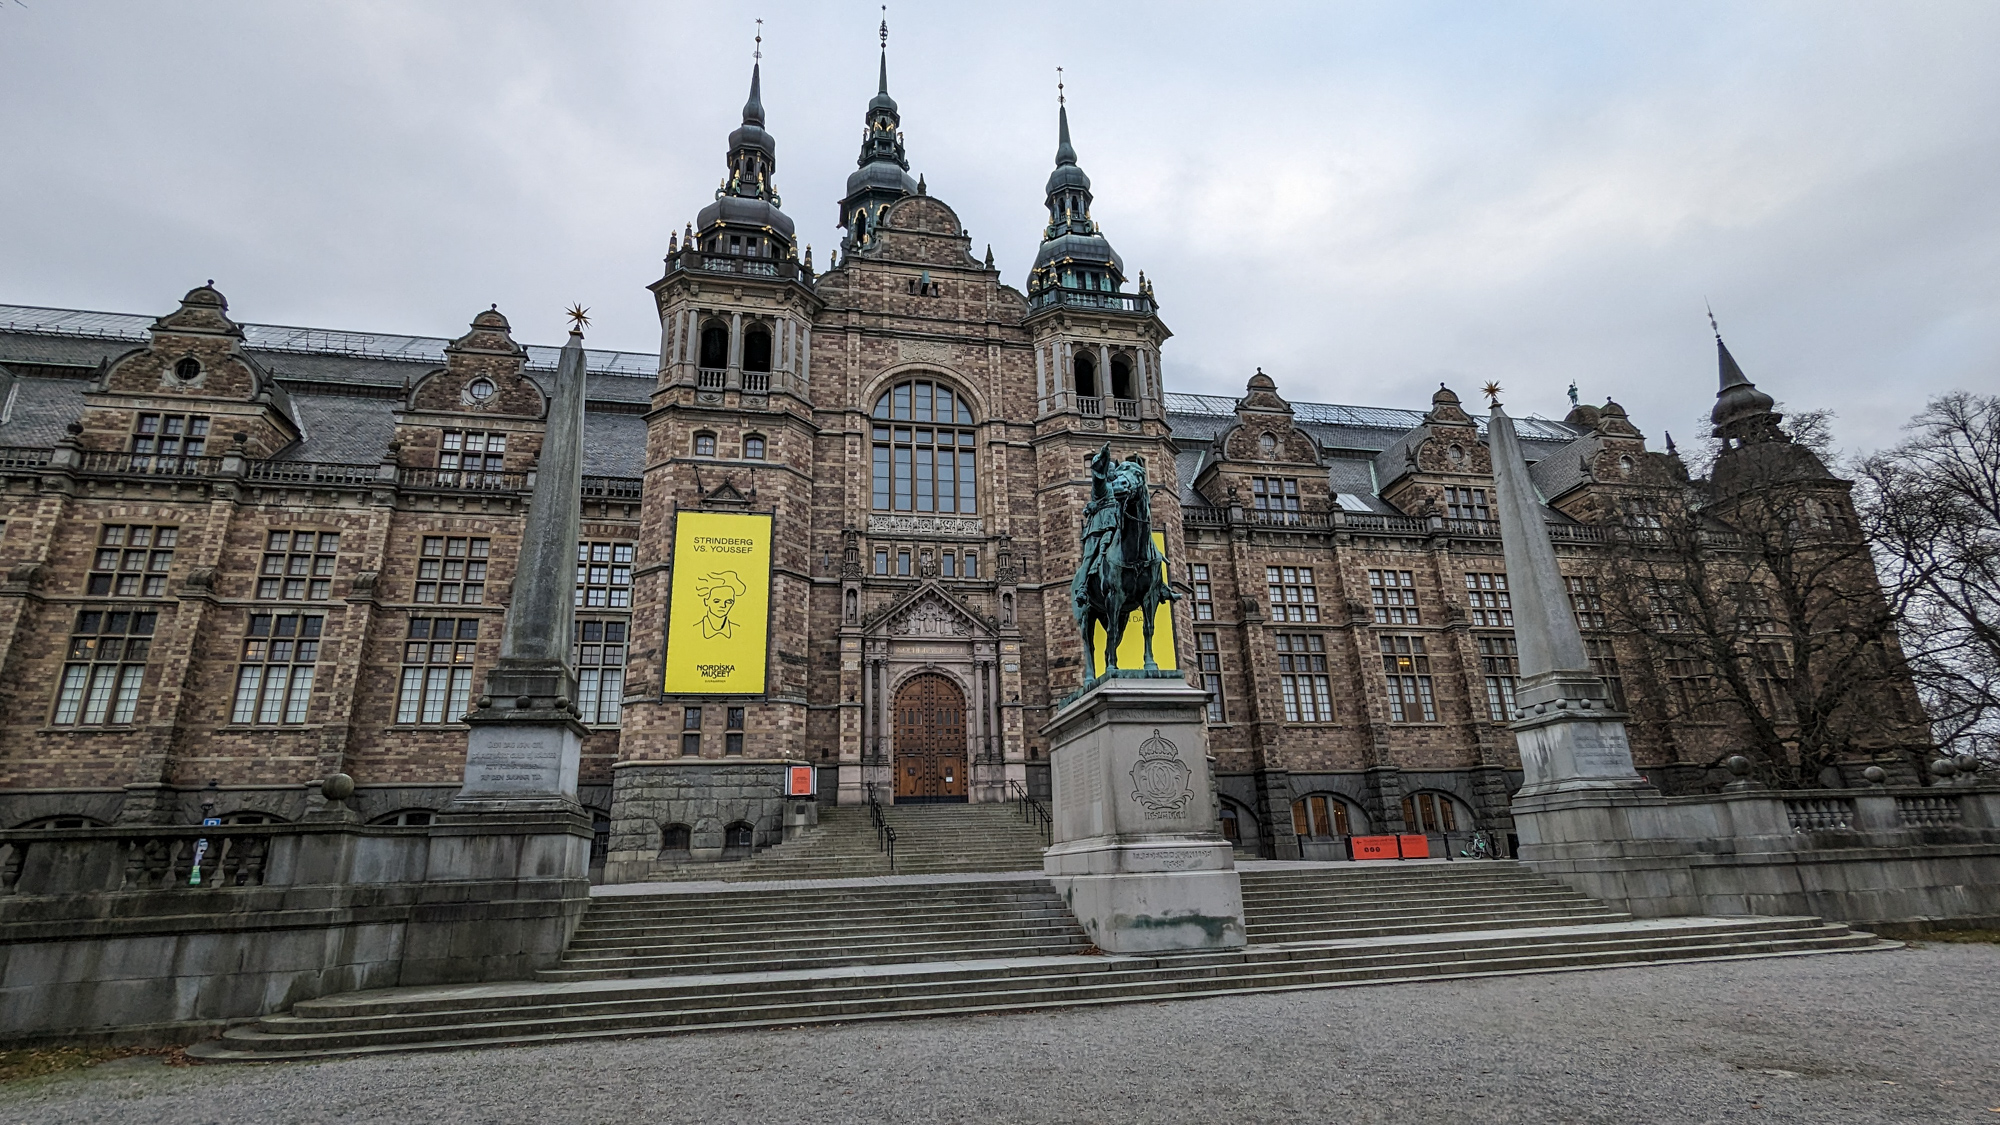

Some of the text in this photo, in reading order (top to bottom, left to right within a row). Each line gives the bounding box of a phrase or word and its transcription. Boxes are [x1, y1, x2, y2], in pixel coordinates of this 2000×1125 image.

[693, 536, 753, 546] STRINDBERG
[693, 545, 753, 554] VS. YOUSSEF
[696, 663, 735, 671] NORDISKA
[701, 670, 731, 679] MUSEET
